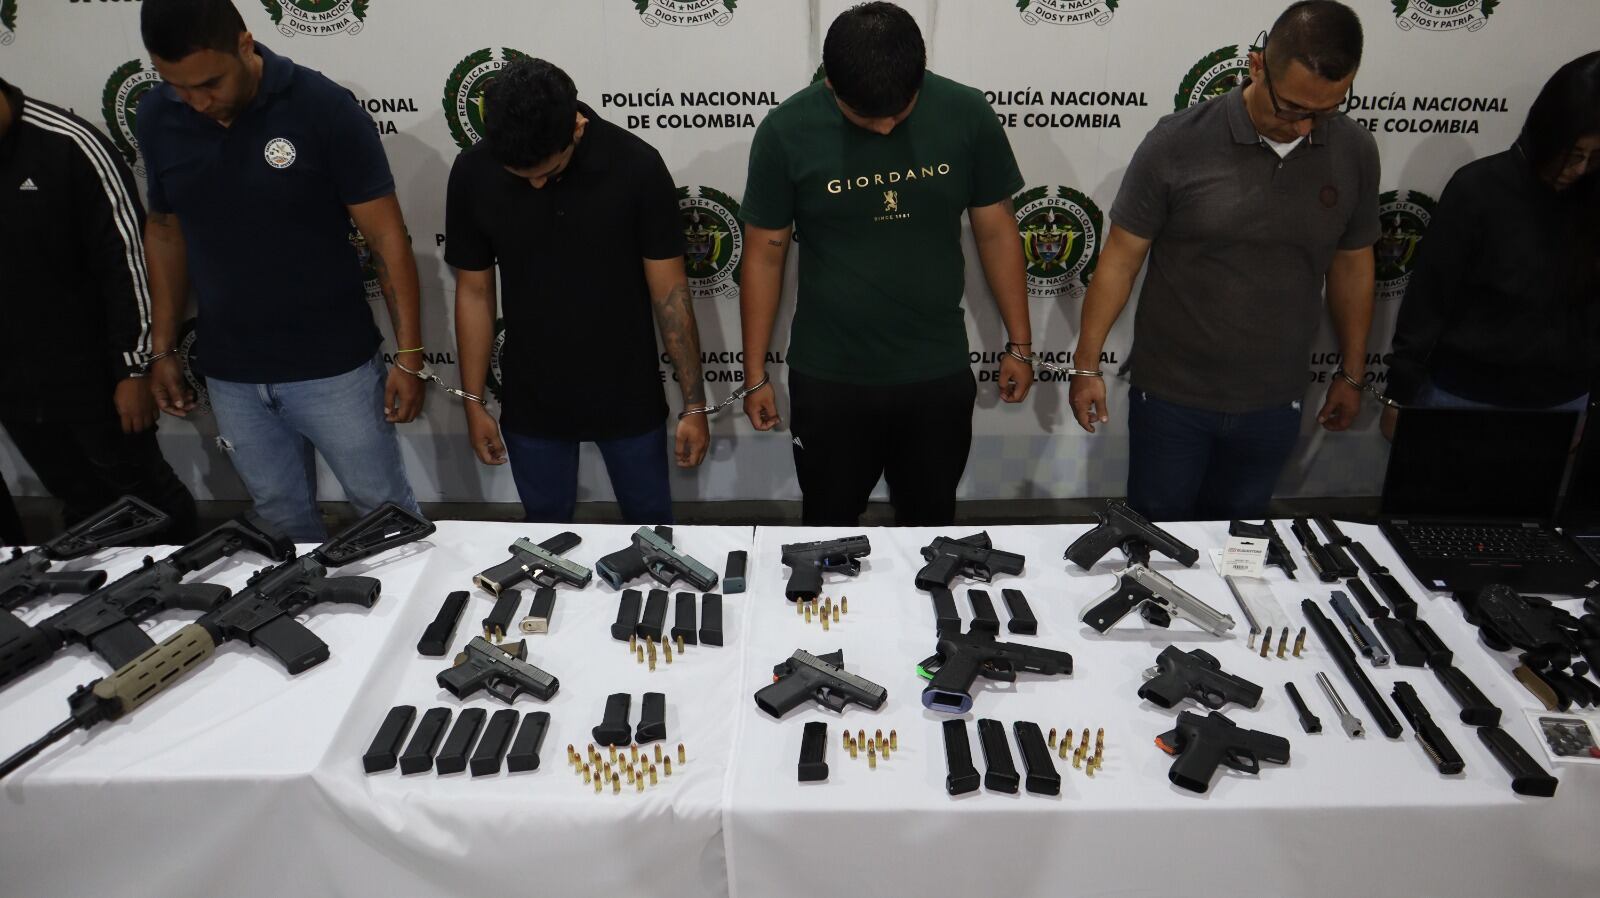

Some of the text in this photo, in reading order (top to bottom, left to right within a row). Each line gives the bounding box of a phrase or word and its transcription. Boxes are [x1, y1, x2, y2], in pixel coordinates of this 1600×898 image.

[319, 0, 351, 20] NACION
[687, 8, 719, 23] PATRIA
[1067, 8, 1100, 22] PATRIA
[320, 18, 350, 32] PATRIA
[1440, 14, 1474, 28] PATRIA
[145, 72, 158, 80] DE
[1190, 64, 1226, 106] EPÚBLICA
[602, 88, 780, 108] POLICÍA NACIONAL
[984, 87, 1148, 106] OLICÍA NACIONAL
[360, 98, 418, 112] IONAL
[1412, 97, 1508, 112] NACIONAL
[628, 114, 756, 128] DE COLOMBIA
[1024, 113, 1121, 128] COLOMBIA
[1384, 118, 1479, 134] COLOMBIA
[827, 163, 950, 194] GIORDANO
[712, 204, 741, 250] COLOMBIA
[1068, 204, 1092, 250] COLOMBIA
[700, 259, 738, 286] NACIONAL
[1046, 258, 1088, 285] NACIONAL
[700, 284, 729, 296] PATRIA
[1045, 282, 1074, 296] PATRIA
